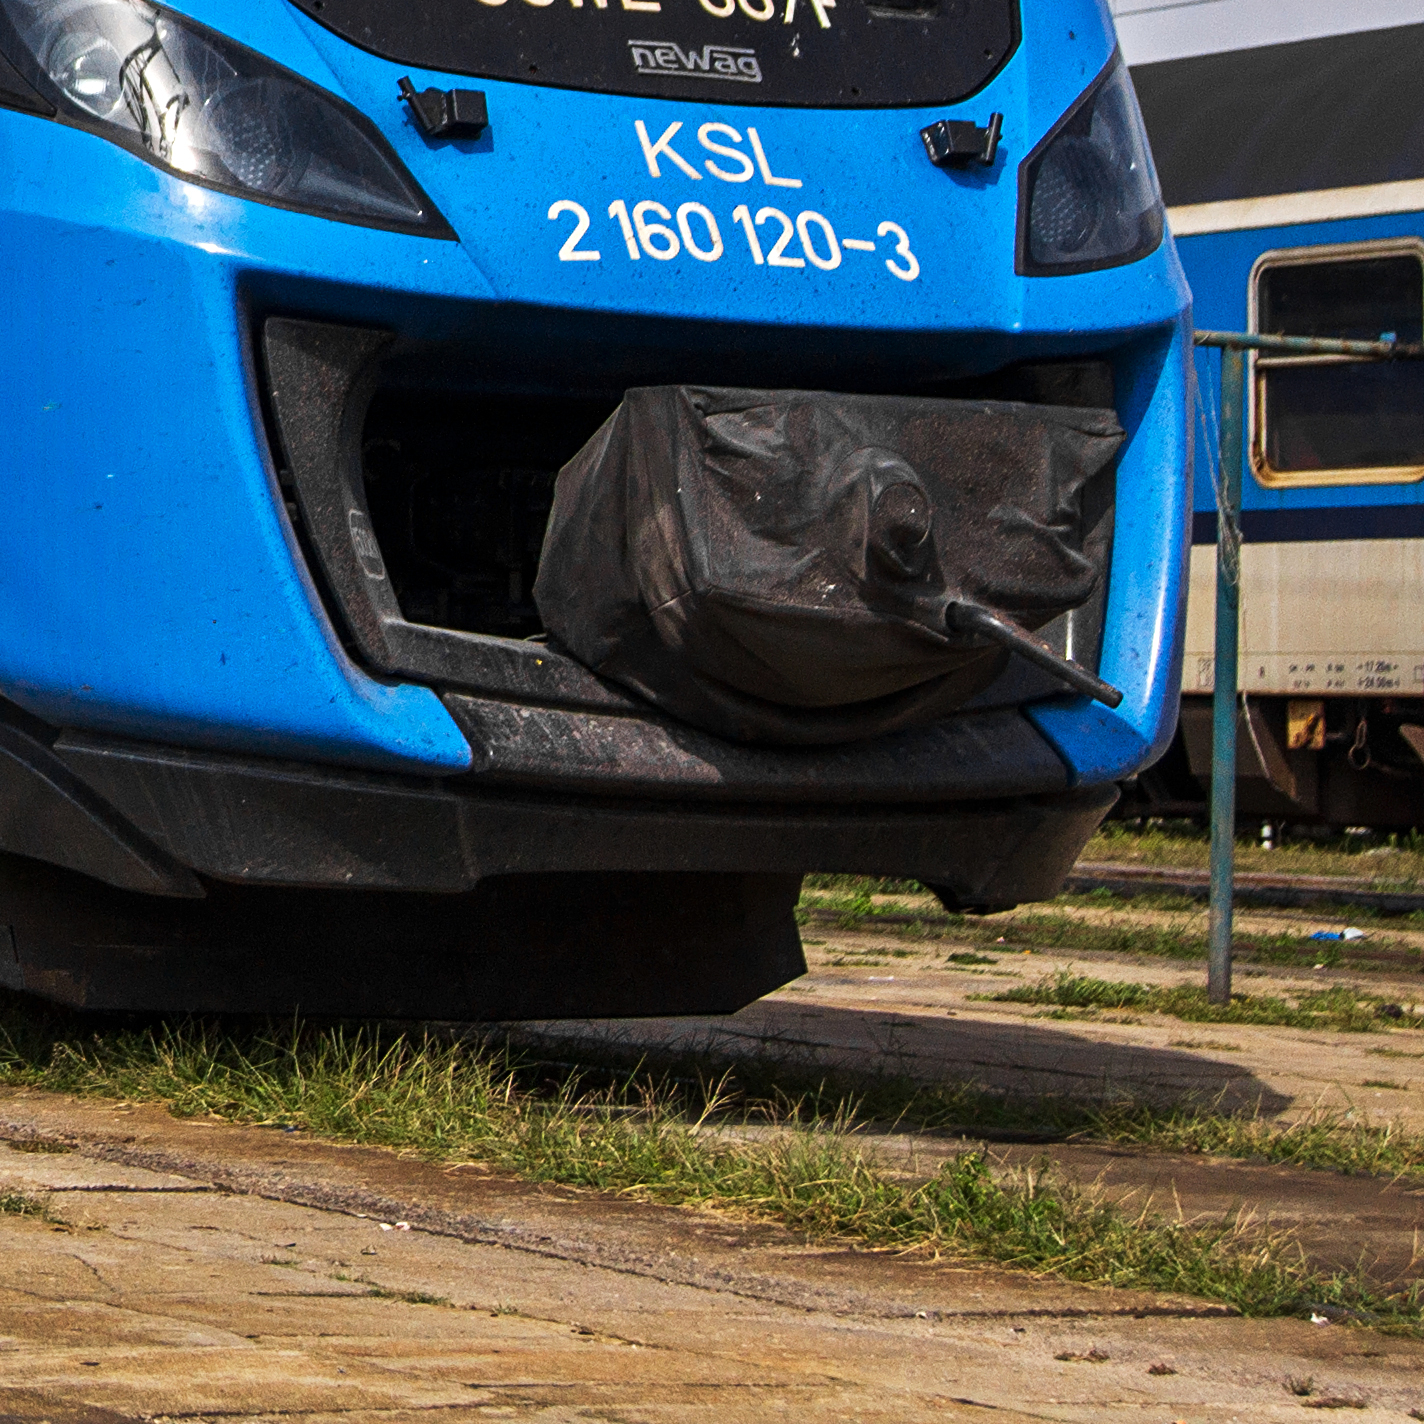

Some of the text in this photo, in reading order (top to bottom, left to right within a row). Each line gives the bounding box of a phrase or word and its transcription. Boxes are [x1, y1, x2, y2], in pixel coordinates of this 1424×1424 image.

[634, 119, 803, 189] KSL
[547, 199, 920, 282] 2 160 120-3
